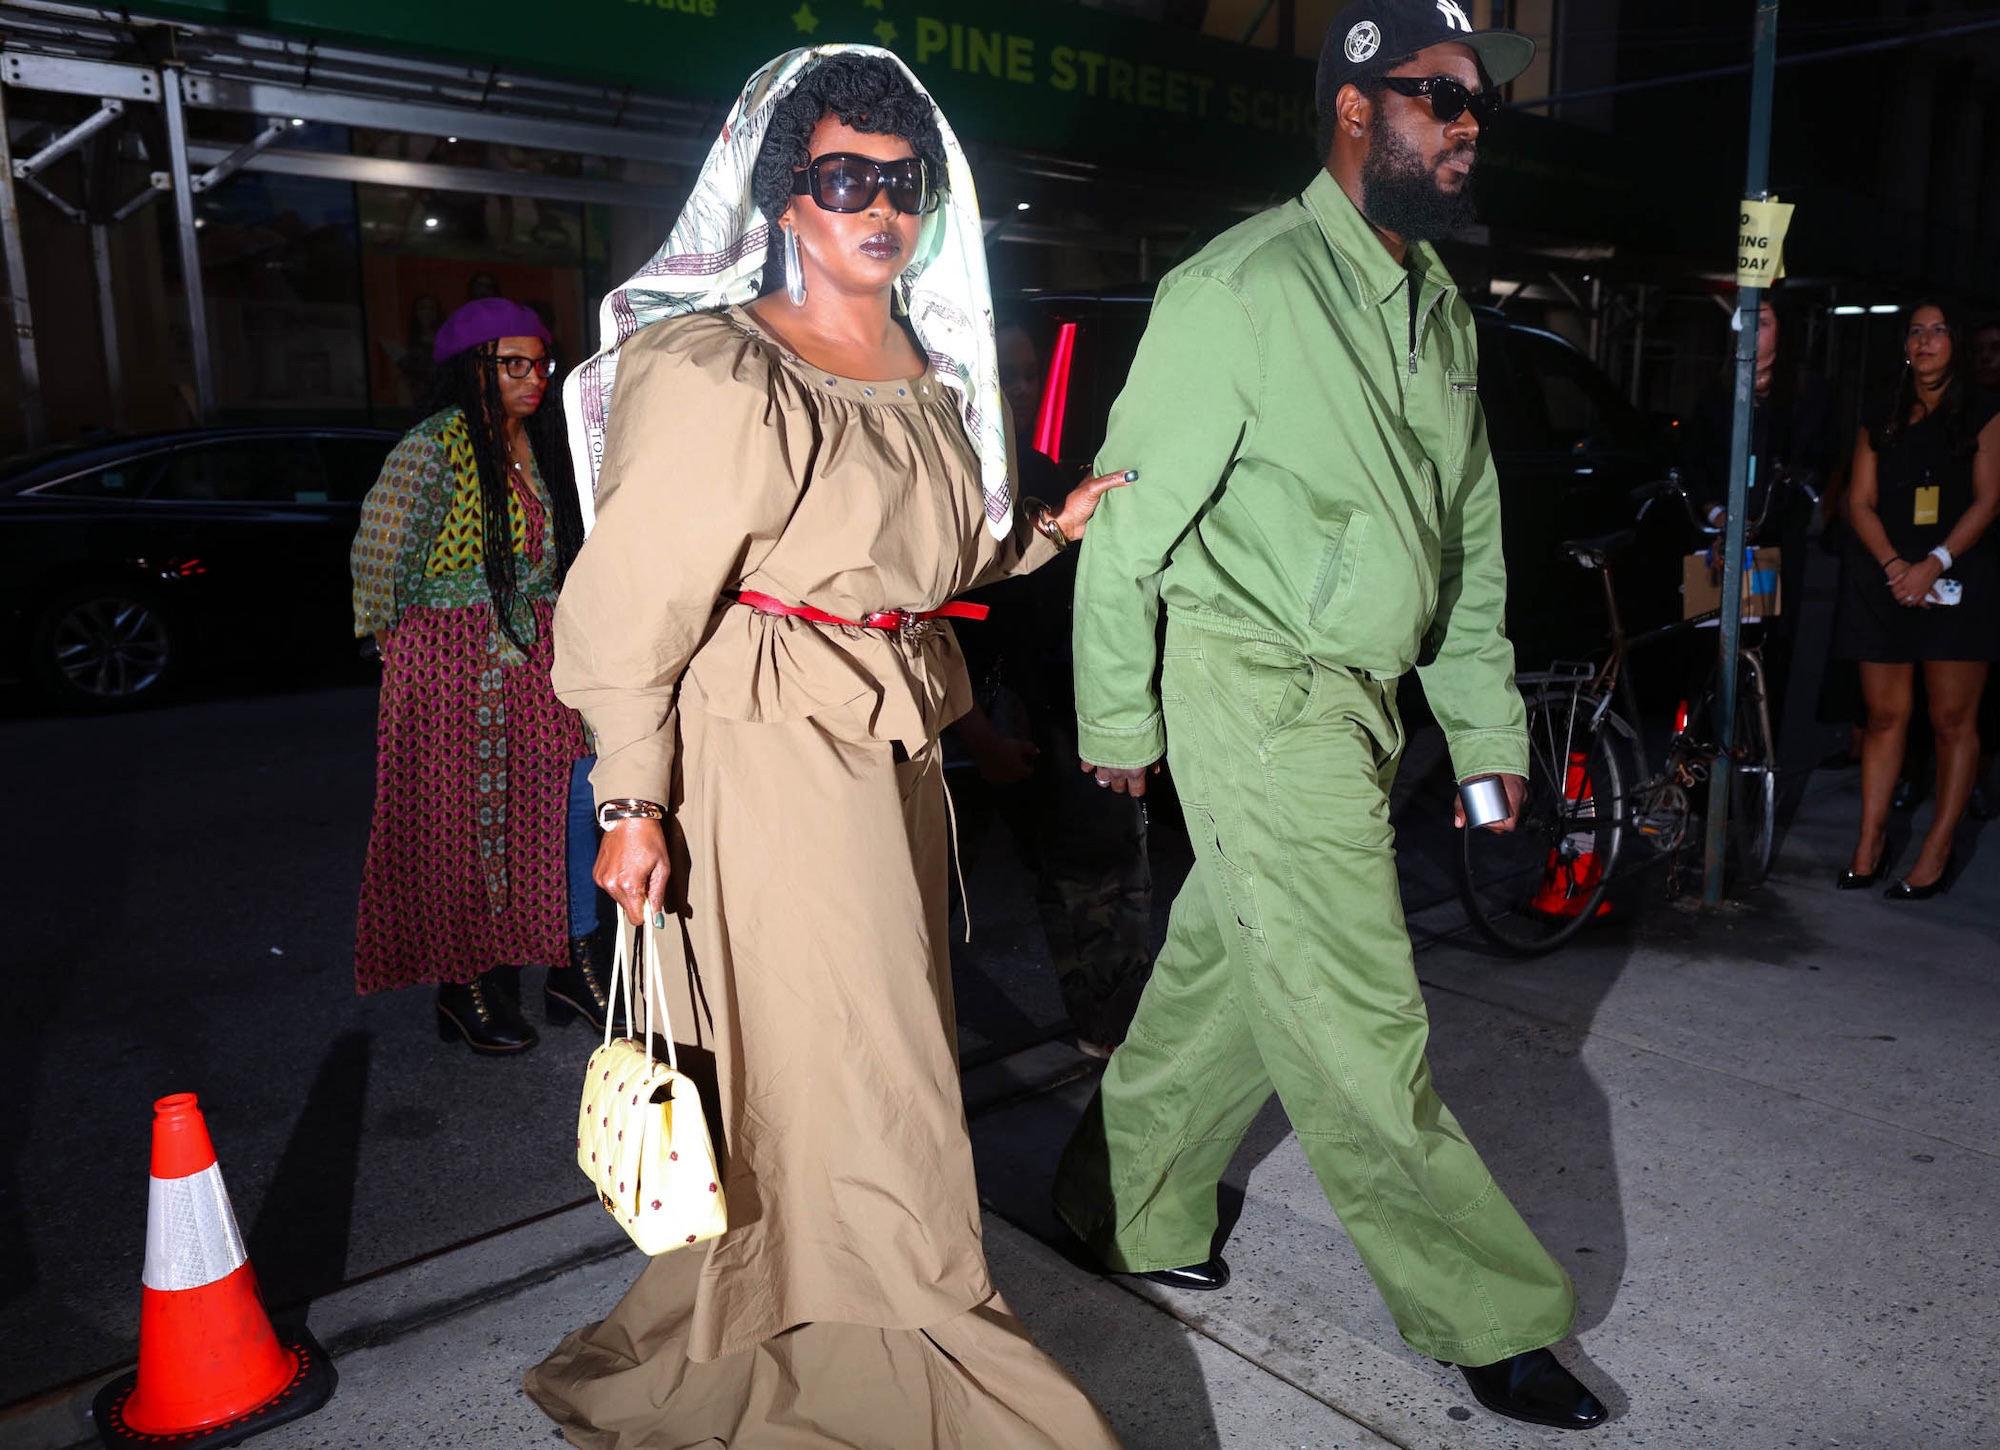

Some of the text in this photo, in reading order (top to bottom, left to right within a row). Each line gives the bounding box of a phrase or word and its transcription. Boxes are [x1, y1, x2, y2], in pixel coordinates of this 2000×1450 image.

[916, 17, 1034, 84] PINE
[1050, 46, 1217, 117] STREET
[1739, 214, 1750, 225] O
[1739, 236, 1768, 249] ING
[1738, 257, 1769, 270] DAY
[592, 431, 604, 472] TOR
